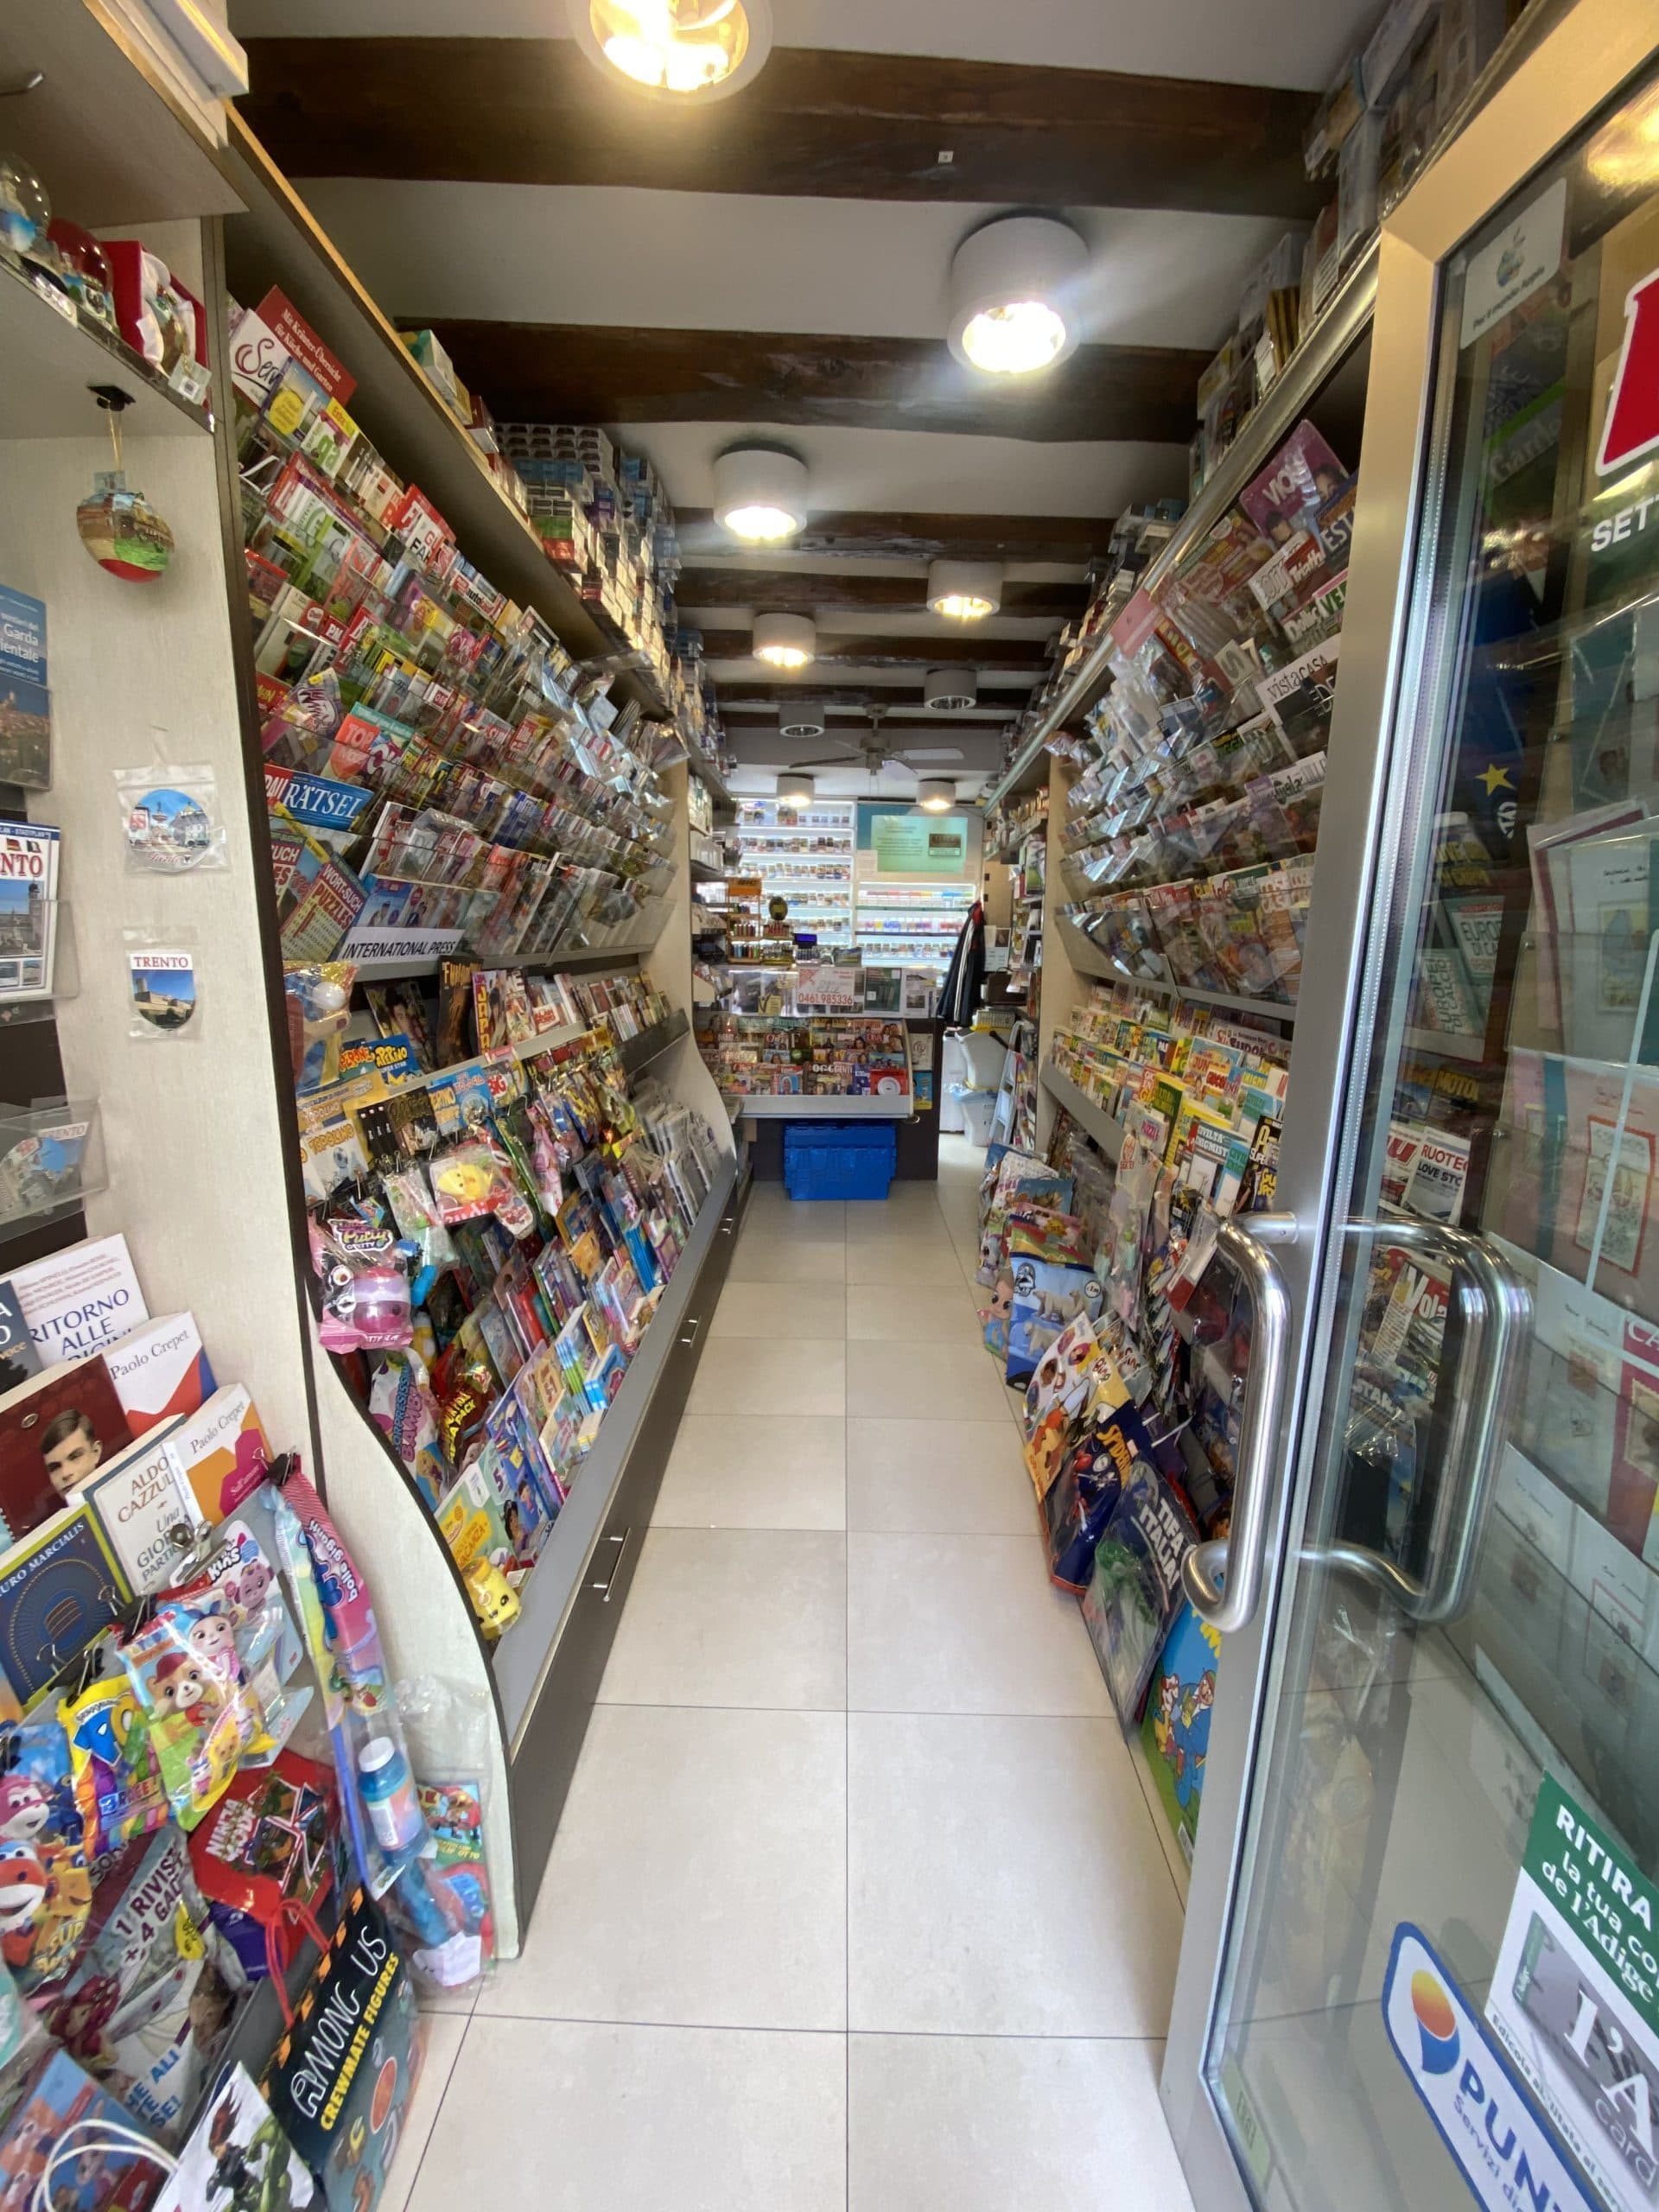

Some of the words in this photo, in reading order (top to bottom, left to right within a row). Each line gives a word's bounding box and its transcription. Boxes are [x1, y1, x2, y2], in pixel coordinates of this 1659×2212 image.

[3, 623, 39, 647] Garda
[283, 782, 363, 819] RÄTSEL
[133, 956, 189, 969] TRENTO
[342, 940, 429, 959] INTERNATIONAL
[429, 940, 457, 955] PRESS
[308, 1123, 356, 1155] TOPOLINO
[29, 1288, 130, 1344] RITORNO
[61, 1316, 115, 1357] ALLE
[110, 1354, 149, 1381] Paolo
[150, 1329, 190, 1357] Crepet
[189, 1427, 219, 1454] Paolo
[218, 1400, 245, 1429] Crepet
[130, 1456, 170, 1496] ALDO
[156, 1506, 181, 1534] Una
[28, 1522, 84, 1573] MARCIALIS
[1555, 1803, 1652, 1933] RITIRA
[1561, 1850, 1581, 1885] la
[1586, 1879, 1624, 1936] tua
[1541, 1860, 1568, 1898] de
[1570, 1891, 1655, 2004] l'Adige
[289, 1981, 361, 2120] AMONG
[349, 1925, 388, 1977] US
[320, 2024, 372, 2132] CREWMATE
[362, 1951, 400, 2025] FIGURES
[1453, 2093, 1501, 2179] Servizi
[1595, 2097, 1656, 2187] Card
